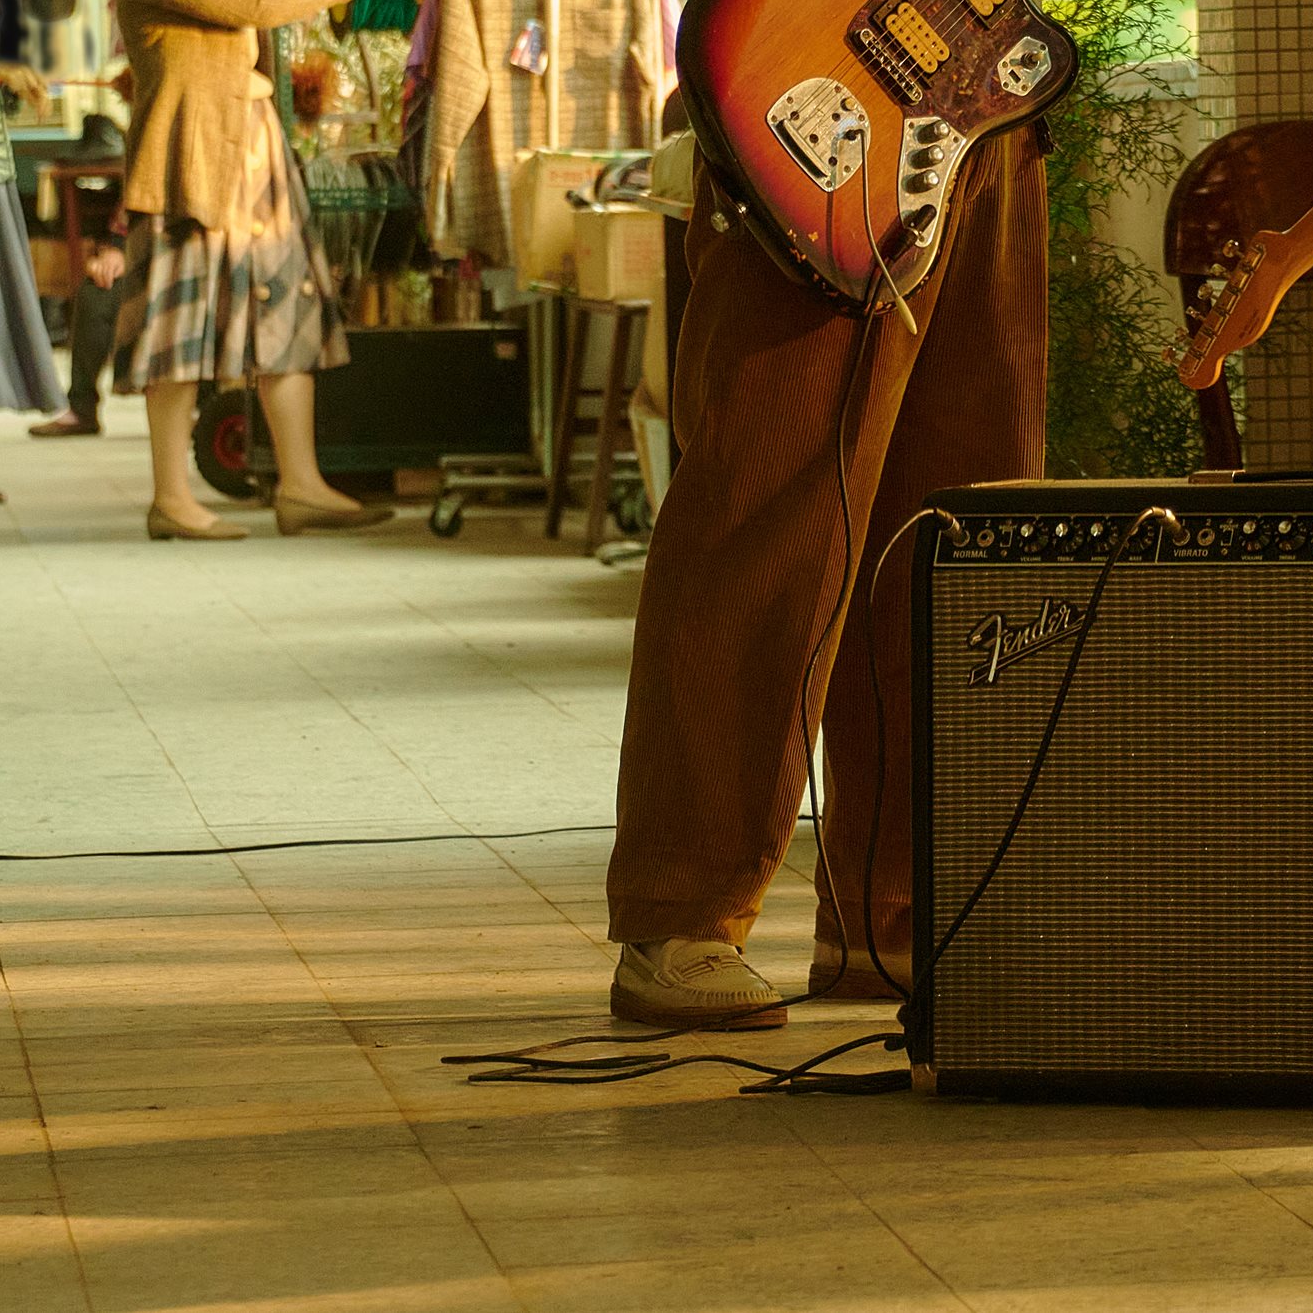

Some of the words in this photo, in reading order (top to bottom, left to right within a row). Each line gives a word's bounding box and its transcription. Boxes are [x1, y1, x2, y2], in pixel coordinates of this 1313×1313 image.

[953, 549, 988, 559] NORMAL
[1173, 549, 1209, 557] VIBRATO
[970, 599, 1087, 684] Fender
